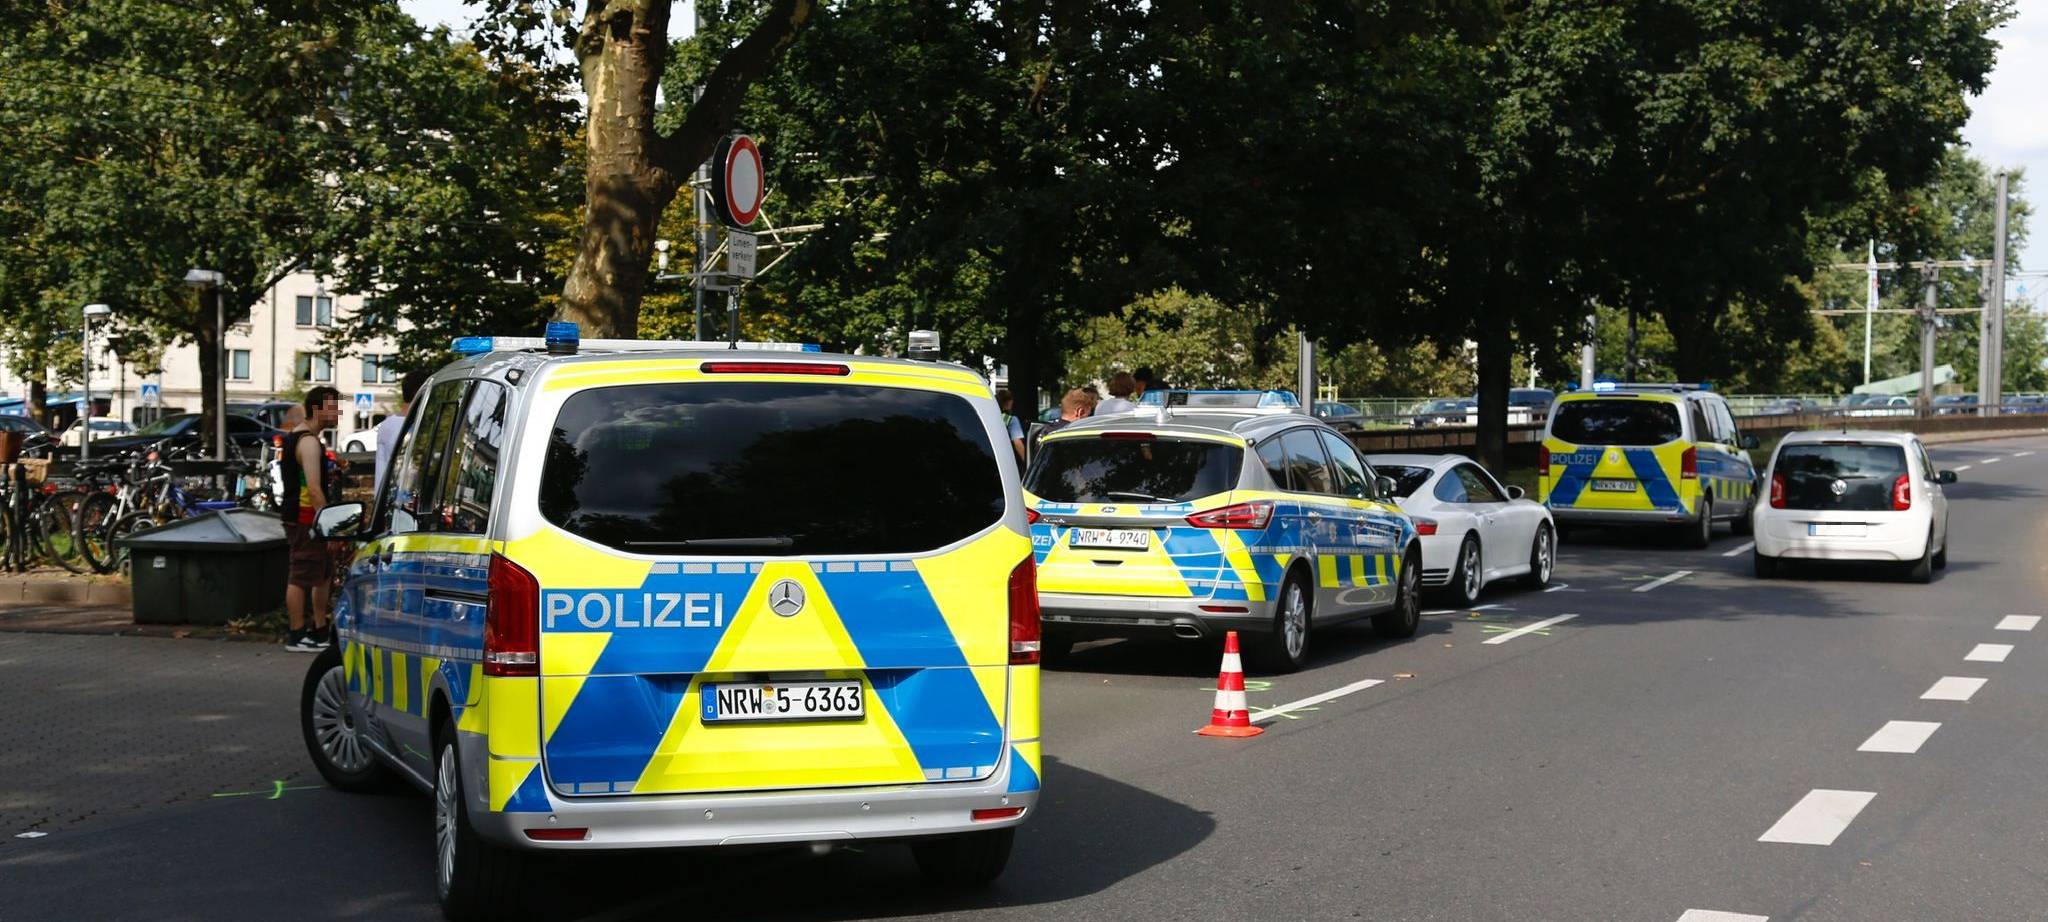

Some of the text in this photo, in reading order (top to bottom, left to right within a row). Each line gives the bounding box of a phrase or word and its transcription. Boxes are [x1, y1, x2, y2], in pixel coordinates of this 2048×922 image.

[1551, 453, 1597, 465] POLIZEI
[1031, 535, 1051, 546] IZEI
[1079, 530, 1099, 543] NRW
[546, 592, 723, 628] POLIZEI
[718, 688, 762, 715] NRW
[777, 686, 861, 713] 5-6363
